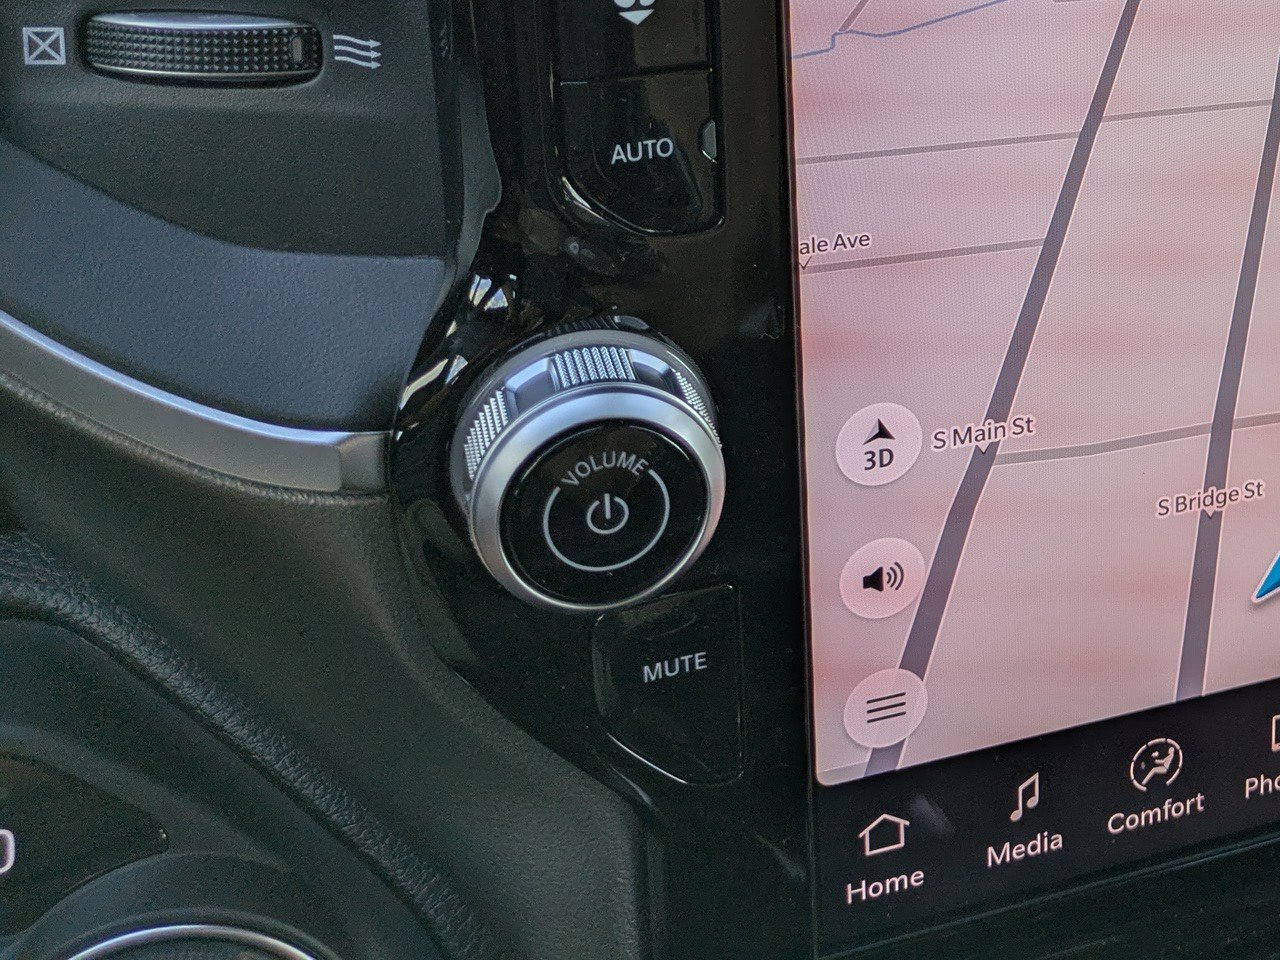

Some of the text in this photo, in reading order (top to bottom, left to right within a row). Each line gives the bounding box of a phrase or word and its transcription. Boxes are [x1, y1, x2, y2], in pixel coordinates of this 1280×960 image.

[610, 137, 674, 165] AUTO
[799, 233, 871, 255] ale Ave
[933, 415, 1035, 450] S Main St
[563, 450, 651, 488] VOLUME
[863, 446, 895, 471] 3D
[1157, 480, 1264, 517] S Bridge St
[642, 650, 709, 684] MUTE
[1107, 791, 1206, 836] Comfort
[986, 830, 1064, 869] Media
[845, 869, 926, 905] Home
